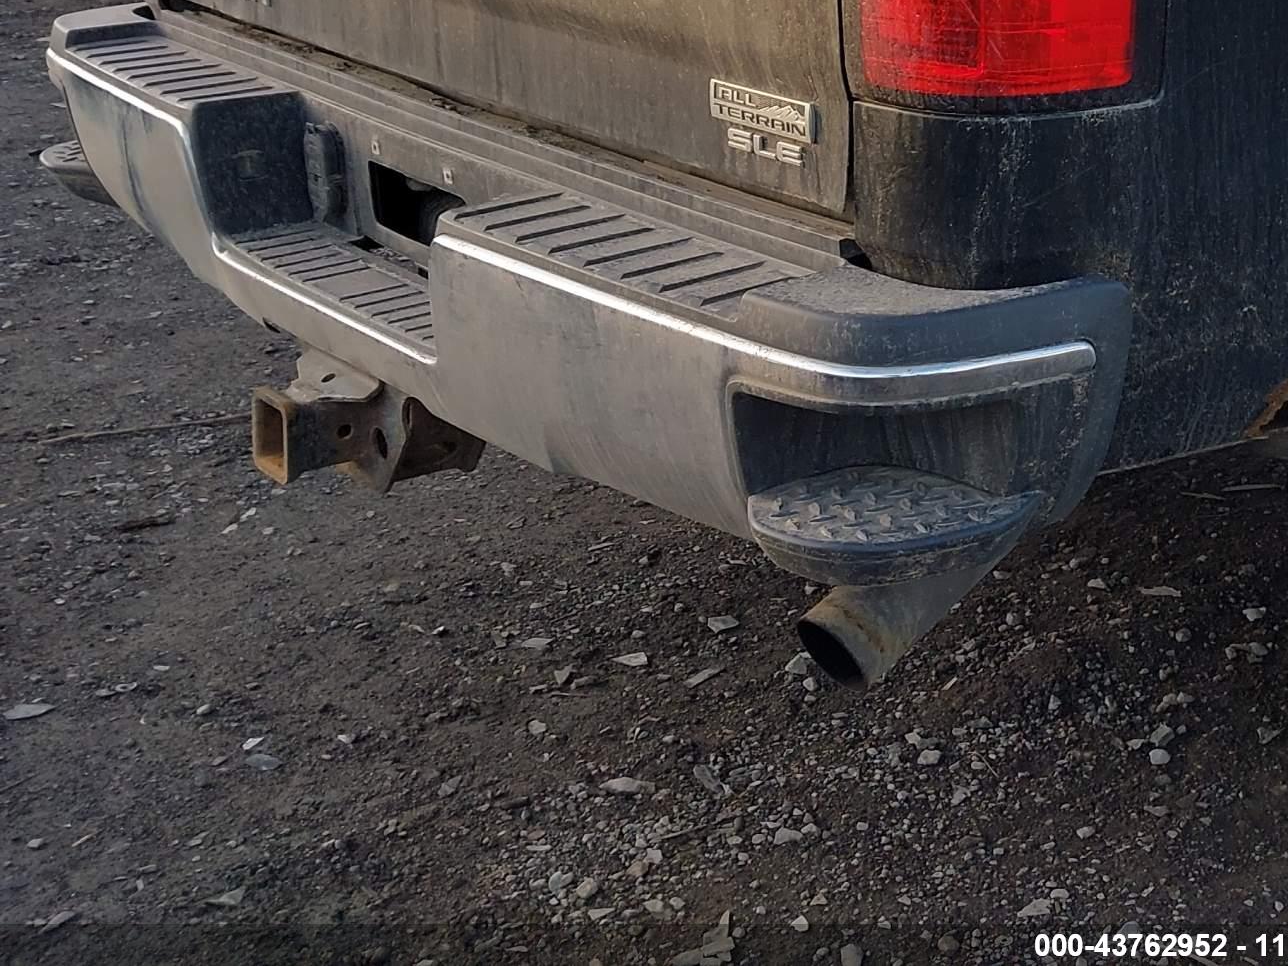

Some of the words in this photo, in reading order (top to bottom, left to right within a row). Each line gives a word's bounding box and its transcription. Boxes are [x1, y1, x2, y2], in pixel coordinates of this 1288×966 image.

[718, 86, 757, 108] ALL
[713, 102, 806, 137] TERRAIN
[727, 127, 804, 167] SLE
